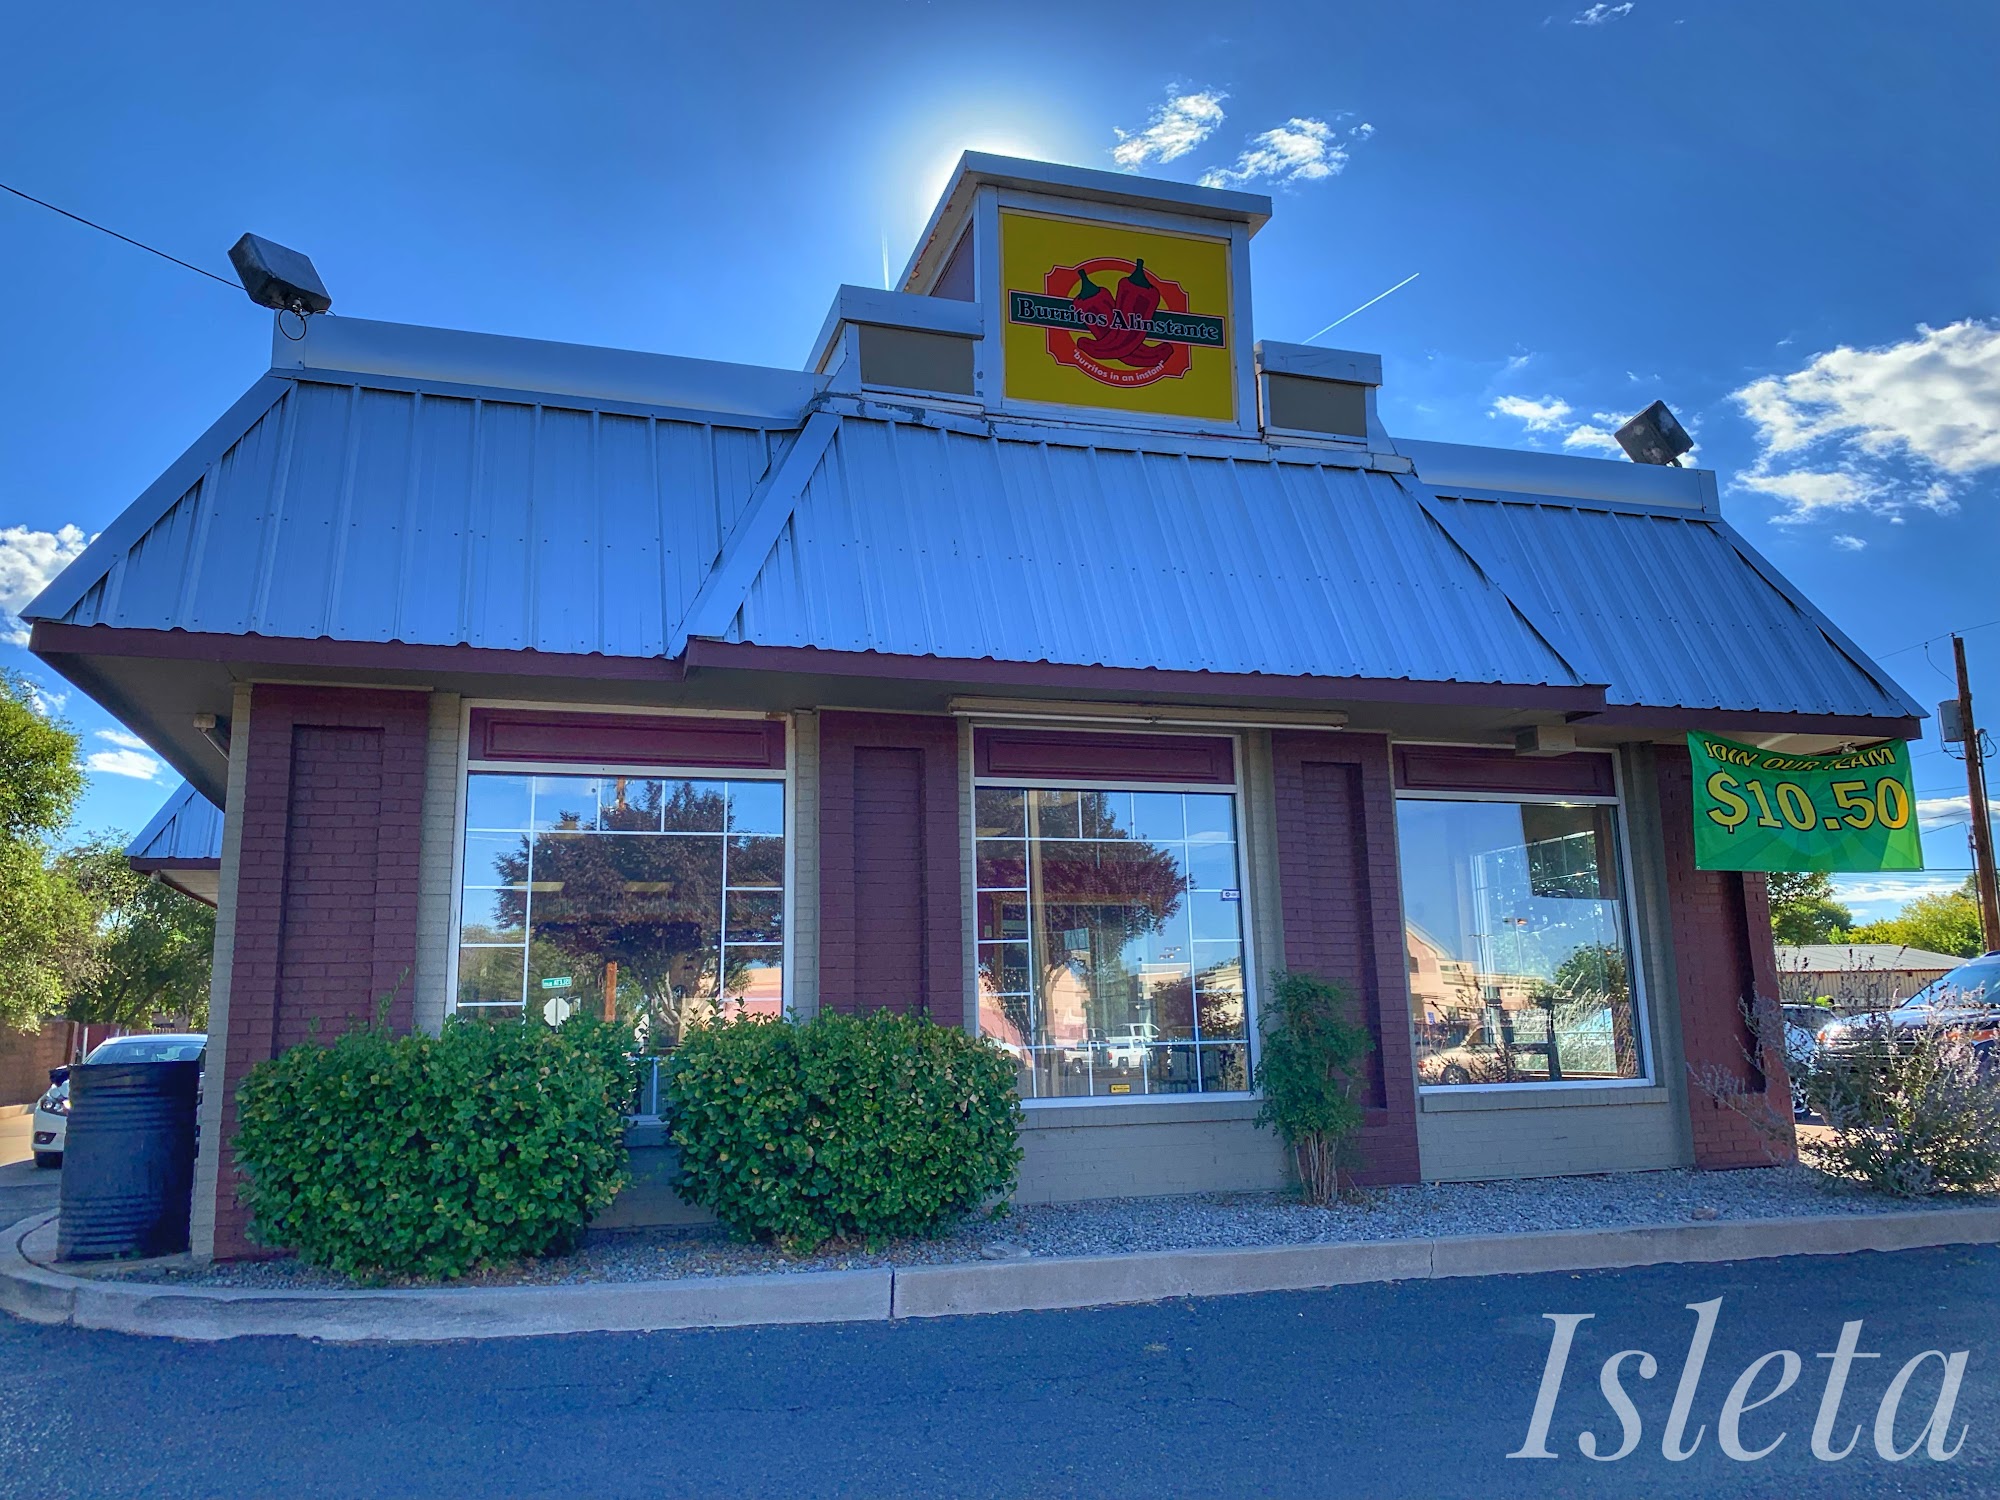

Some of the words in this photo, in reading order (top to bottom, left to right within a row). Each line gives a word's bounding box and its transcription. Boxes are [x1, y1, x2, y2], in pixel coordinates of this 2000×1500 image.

[1017, 297, 1108, 327] Burritos
[1110, 309, 1219, 339] Alinstante
[1110, 371, 1120, 381] in
[1122, 374, 1135, 382] an
[1703, 741, 1759, 767] JOIN
[1762, 757, 1821, 772] OUR
[1822, 748, 1897, 771] TEAM
[1706, 767, 1910, 834] $10.50
